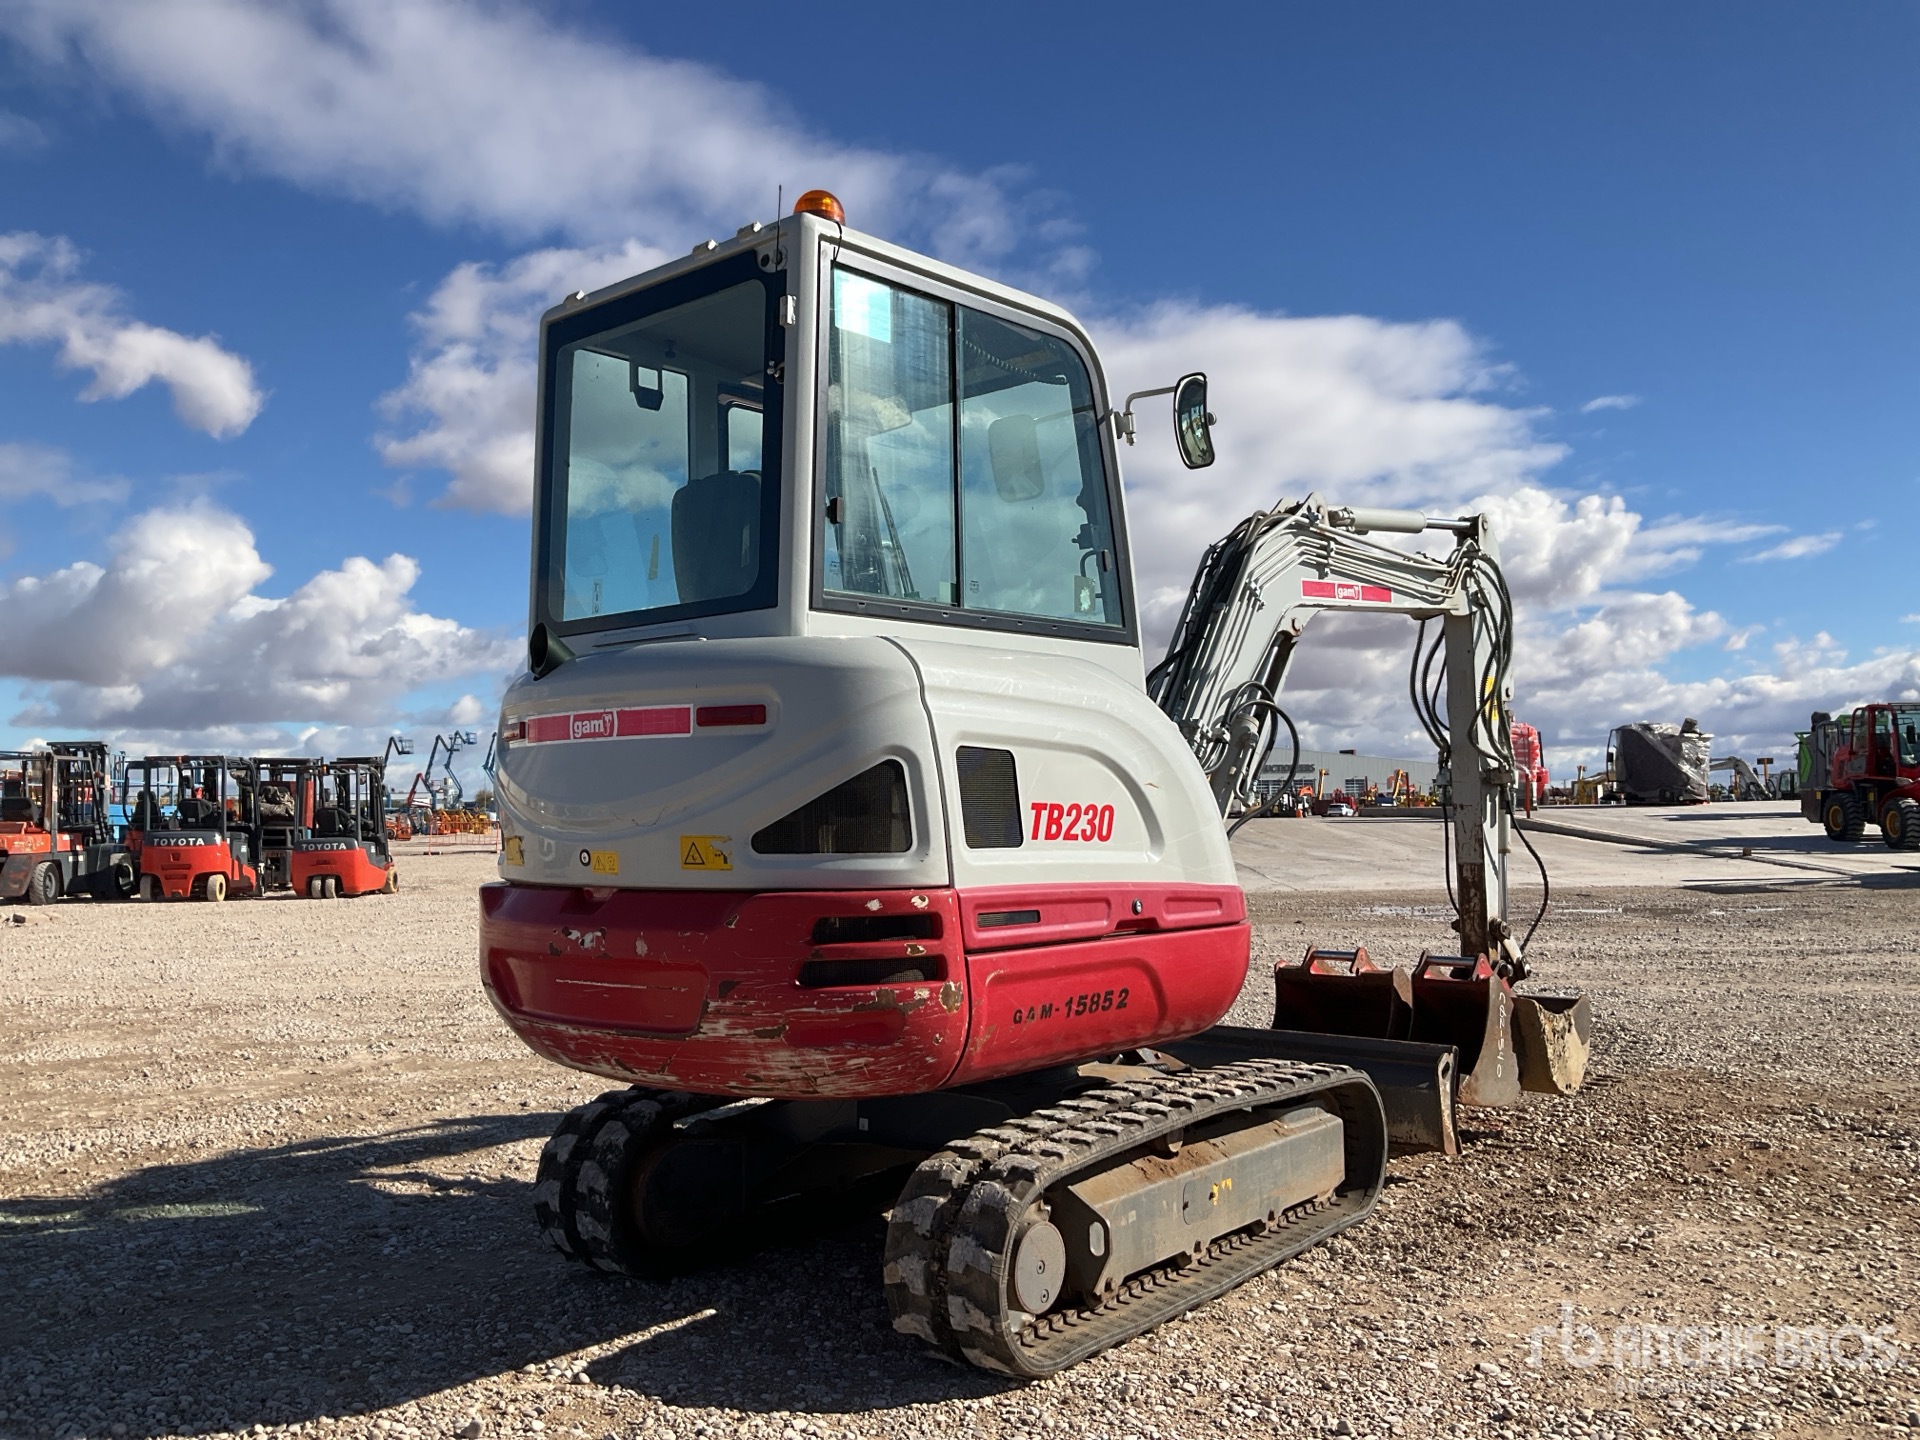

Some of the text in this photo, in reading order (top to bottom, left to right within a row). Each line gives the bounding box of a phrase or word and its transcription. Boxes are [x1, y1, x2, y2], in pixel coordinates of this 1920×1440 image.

[1030, 802, 1115, 842] TB230
[153, 837, 205, 846] TOYOTA
[301, 842, 347, 851] TOYOTA
